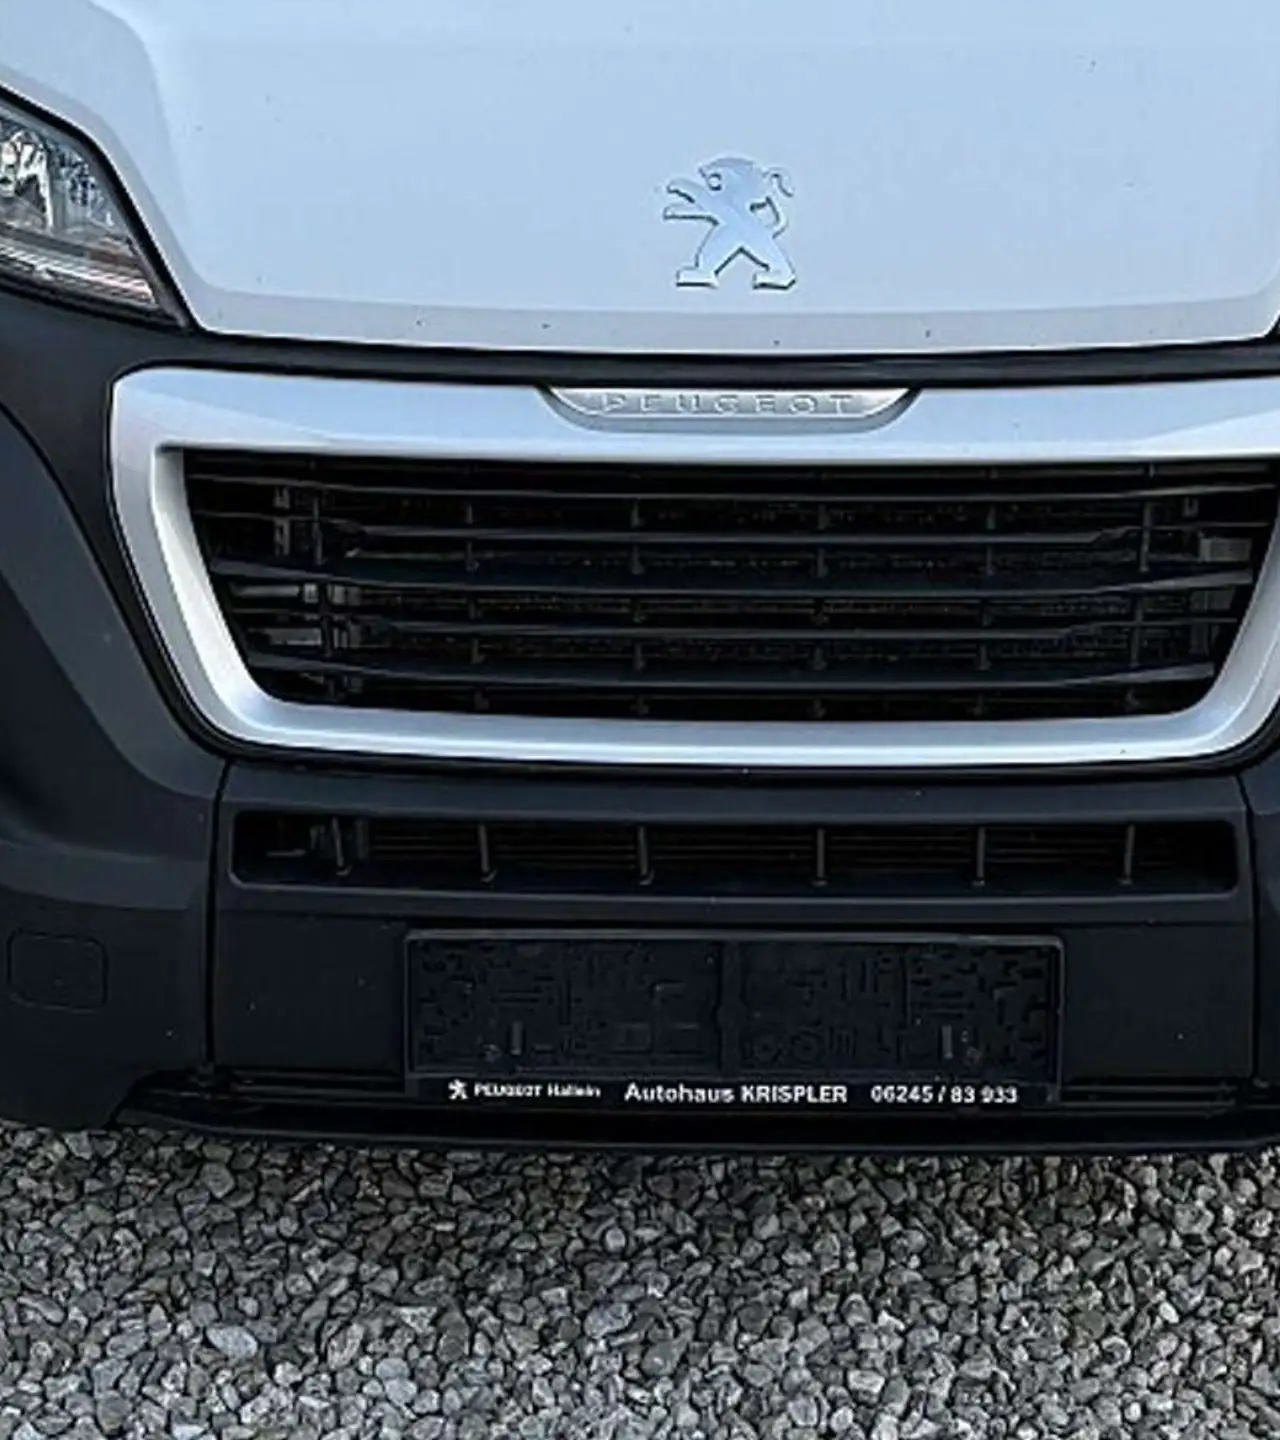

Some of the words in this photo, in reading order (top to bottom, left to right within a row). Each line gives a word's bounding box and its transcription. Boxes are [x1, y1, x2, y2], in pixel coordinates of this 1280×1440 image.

[600, 392, 854, 415] PEUGEOT
[623, 1080, 735, 1104] Autohaus
[740, 1084, 849, 1104] KRISPLER
[870, 1084, 933, 1104] 06245
[950, 1086, 976, 1104] 83
[980, 1086, 1018, 1104] 933
